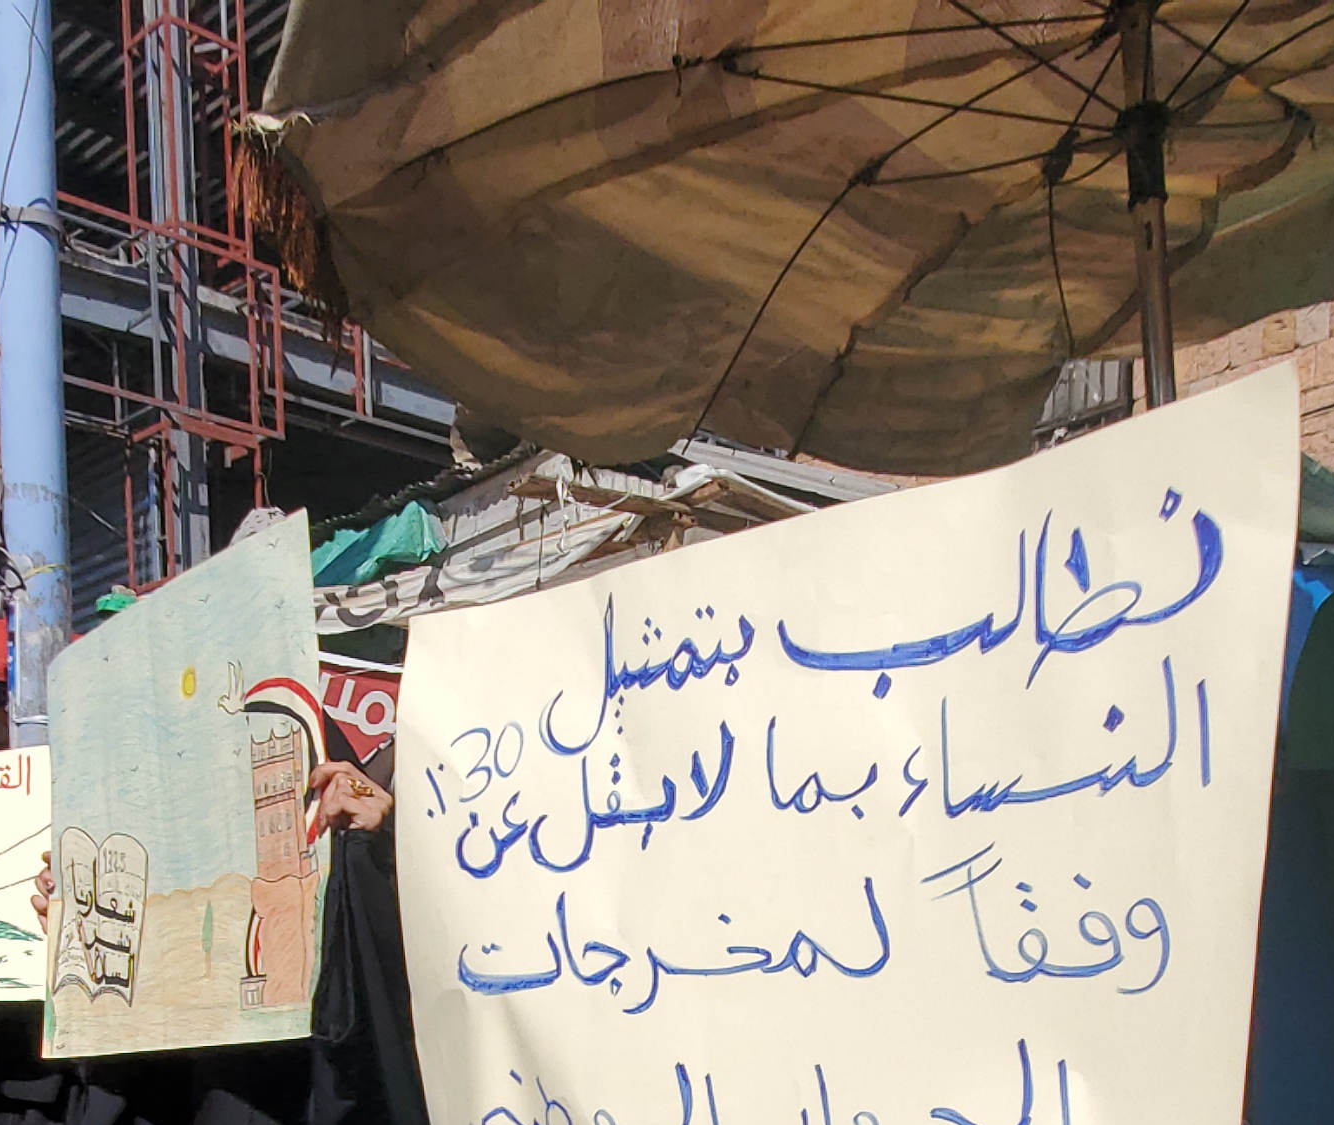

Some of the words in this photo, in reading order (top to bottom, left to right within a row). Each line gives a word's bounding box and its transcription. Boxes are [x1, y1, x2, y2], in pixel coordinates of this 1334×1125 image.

[774, 487, 1226, 698] نطالب
[538, 594, 756, 754] بتمثيل
[898, 656, 1212, 821] النساء
[454, 793, 533, 881] عن
[764, 716, 879, 817] بما
[456, 875, 892, 1016] لمخرجات
